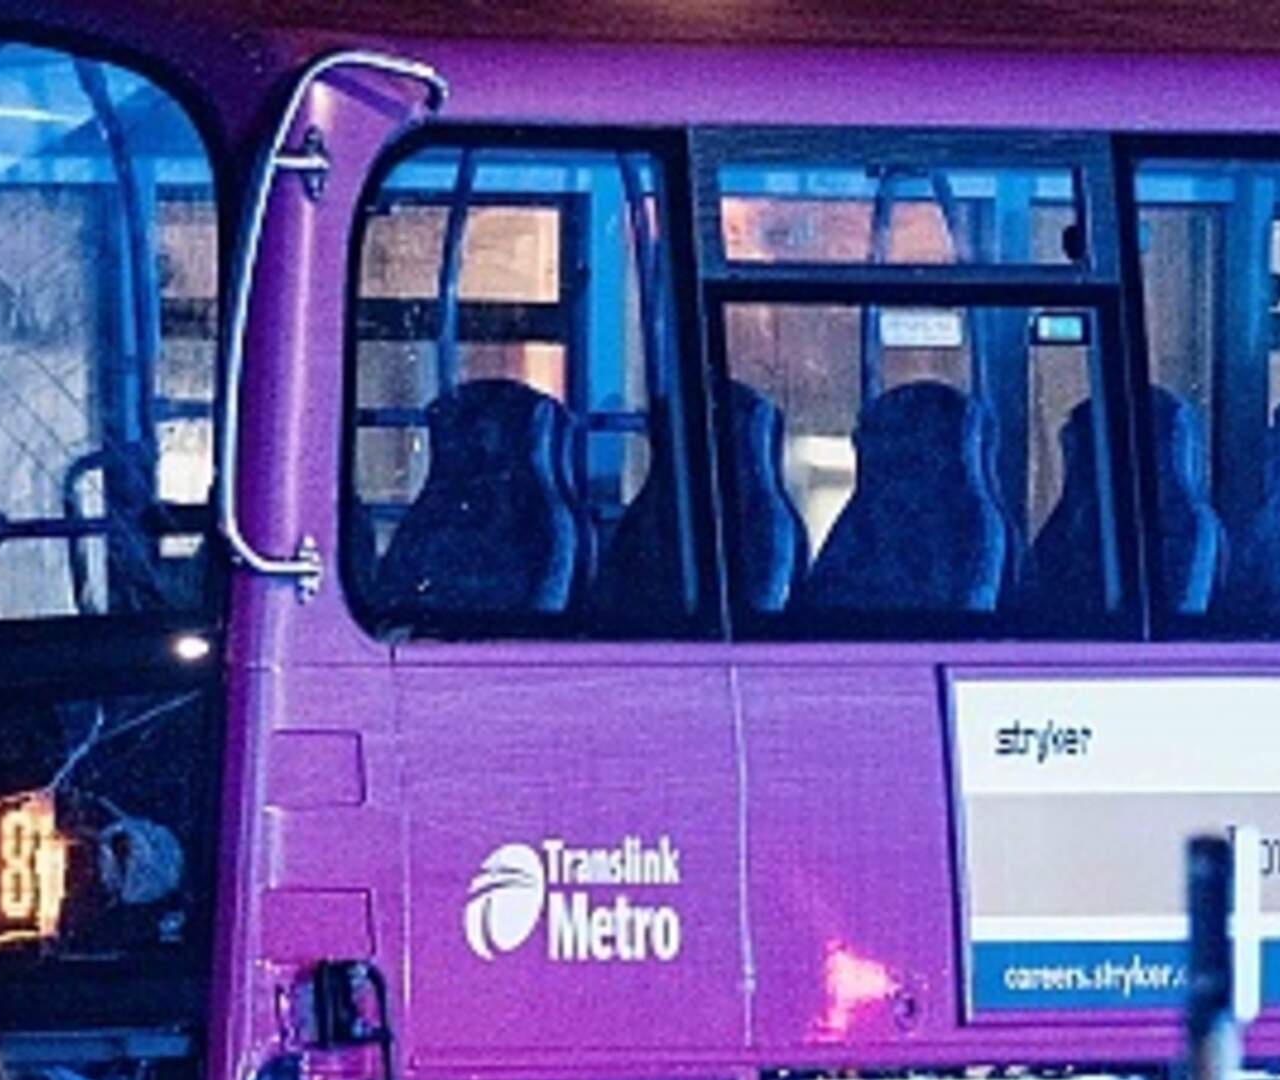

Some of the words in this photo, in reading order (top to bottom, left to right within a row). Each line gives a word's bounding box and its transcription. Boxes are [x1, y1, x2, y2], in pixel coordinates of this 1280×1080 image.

[995, 719, 1090, 763] stryker
[542, 836, 679, 884] Translink
[548, 892, 681, 962] Metro
